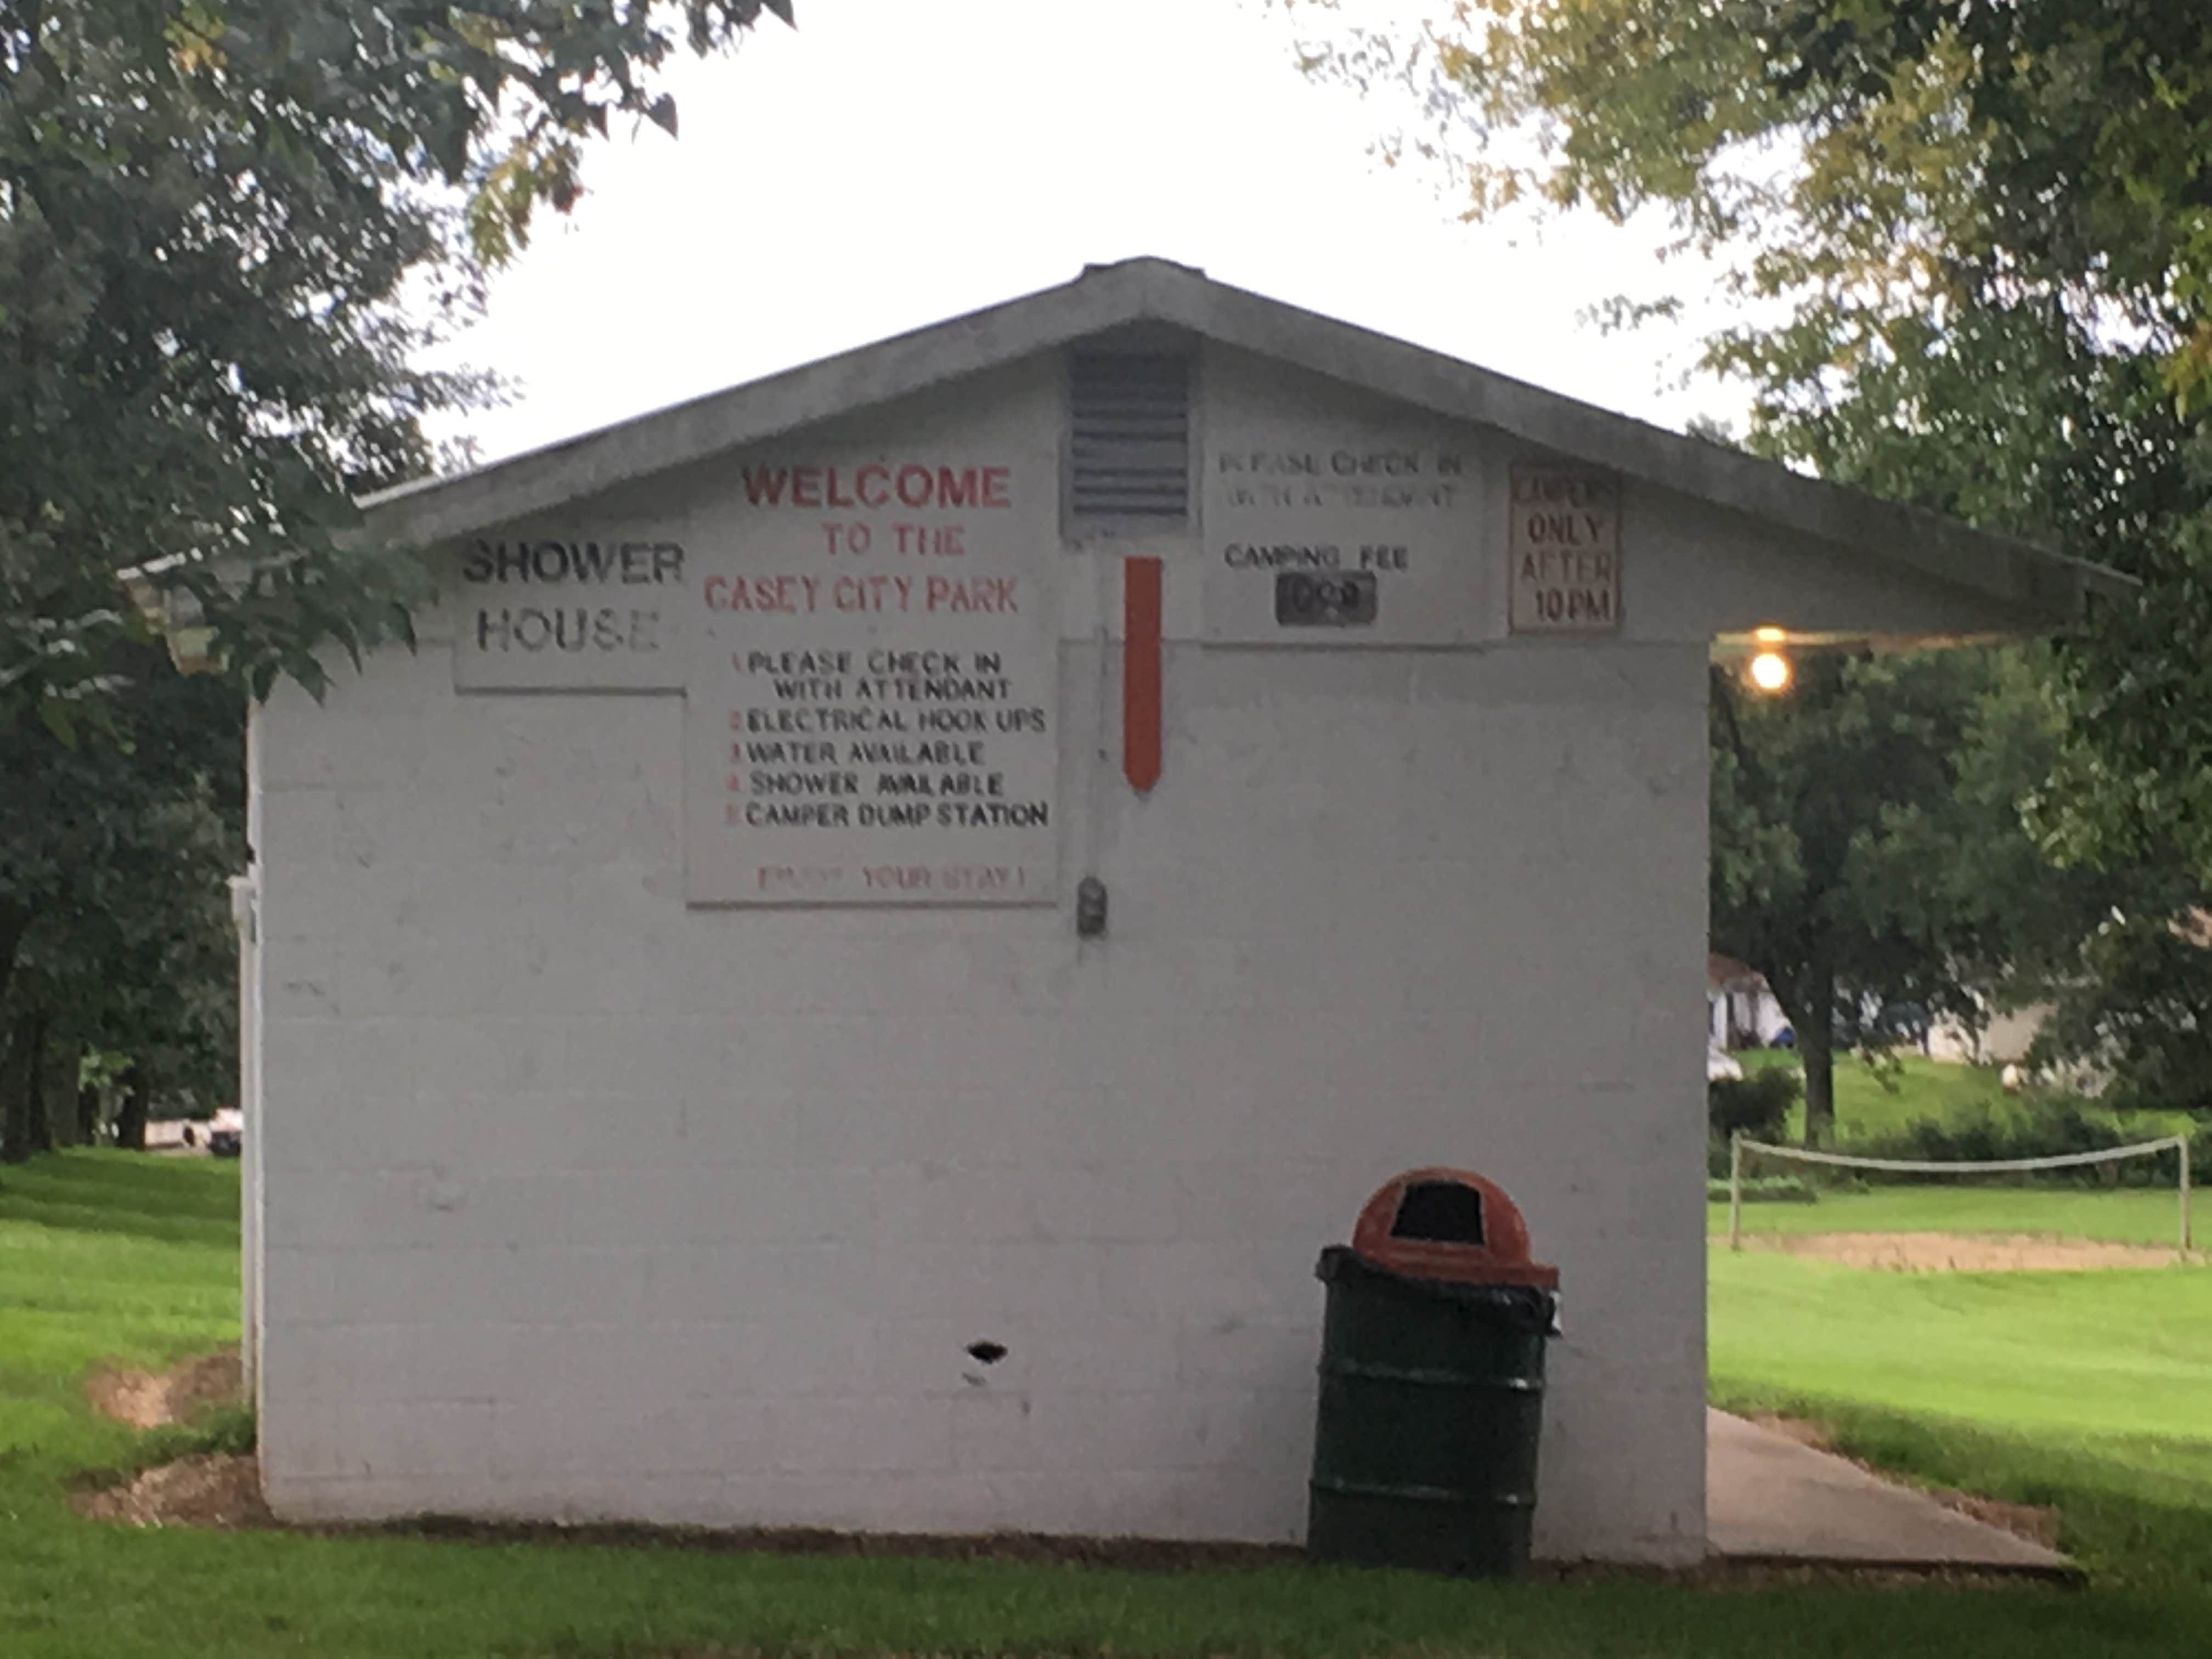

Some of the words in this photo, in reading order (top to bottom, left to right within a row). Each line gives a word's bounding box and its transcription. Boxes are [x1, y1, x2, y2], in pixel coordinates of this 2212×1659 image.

[741, 462, 1013, 509] WELCOME
[821, 520, 872, 556] TO
[890, 521, 967, 556] THE
[1527, 512, 1603, 545] ONLY
[462, 538, 685, 585] SHOWER
[1224, 543, 1341, 569] CAMPING
[1359, 544, 1409, 572] FEE
[1520, 550, 1611, 582] AFTER
[703, 573, 820, 614] CASEY
[833, 573, 912, 613] CITY
[925, 573, 1019, 613] PARK
[1535, 588, 1610, 622] 10PM
[476, 607, 662, 654] HOUSE
[746, 650, 851, 675] PLEASE
[867, 648, 961, 675] CHECK
[974, 651, 1002, 674] IN
[772, 678, 843, 701] WITH
[855, 677, 1013, 701] ATTENDANT
[746, 707, 910, 733] ELECTRICAL
[918, 708, 989, 733] HOOK
[995, 707, 1047, 733] UPS
[746, 741, 838, 765] WATER
[849, 740, 986, 766] AVAILABLE
[749, 770, 859, 797] SHOWER
[877, 771, 1005, 797] AVAILABLE
[745, 802, 849, 827] CAMPER
[857, 802, 932, 830] DUMP
[936, 801, 1049, 827] STATION
